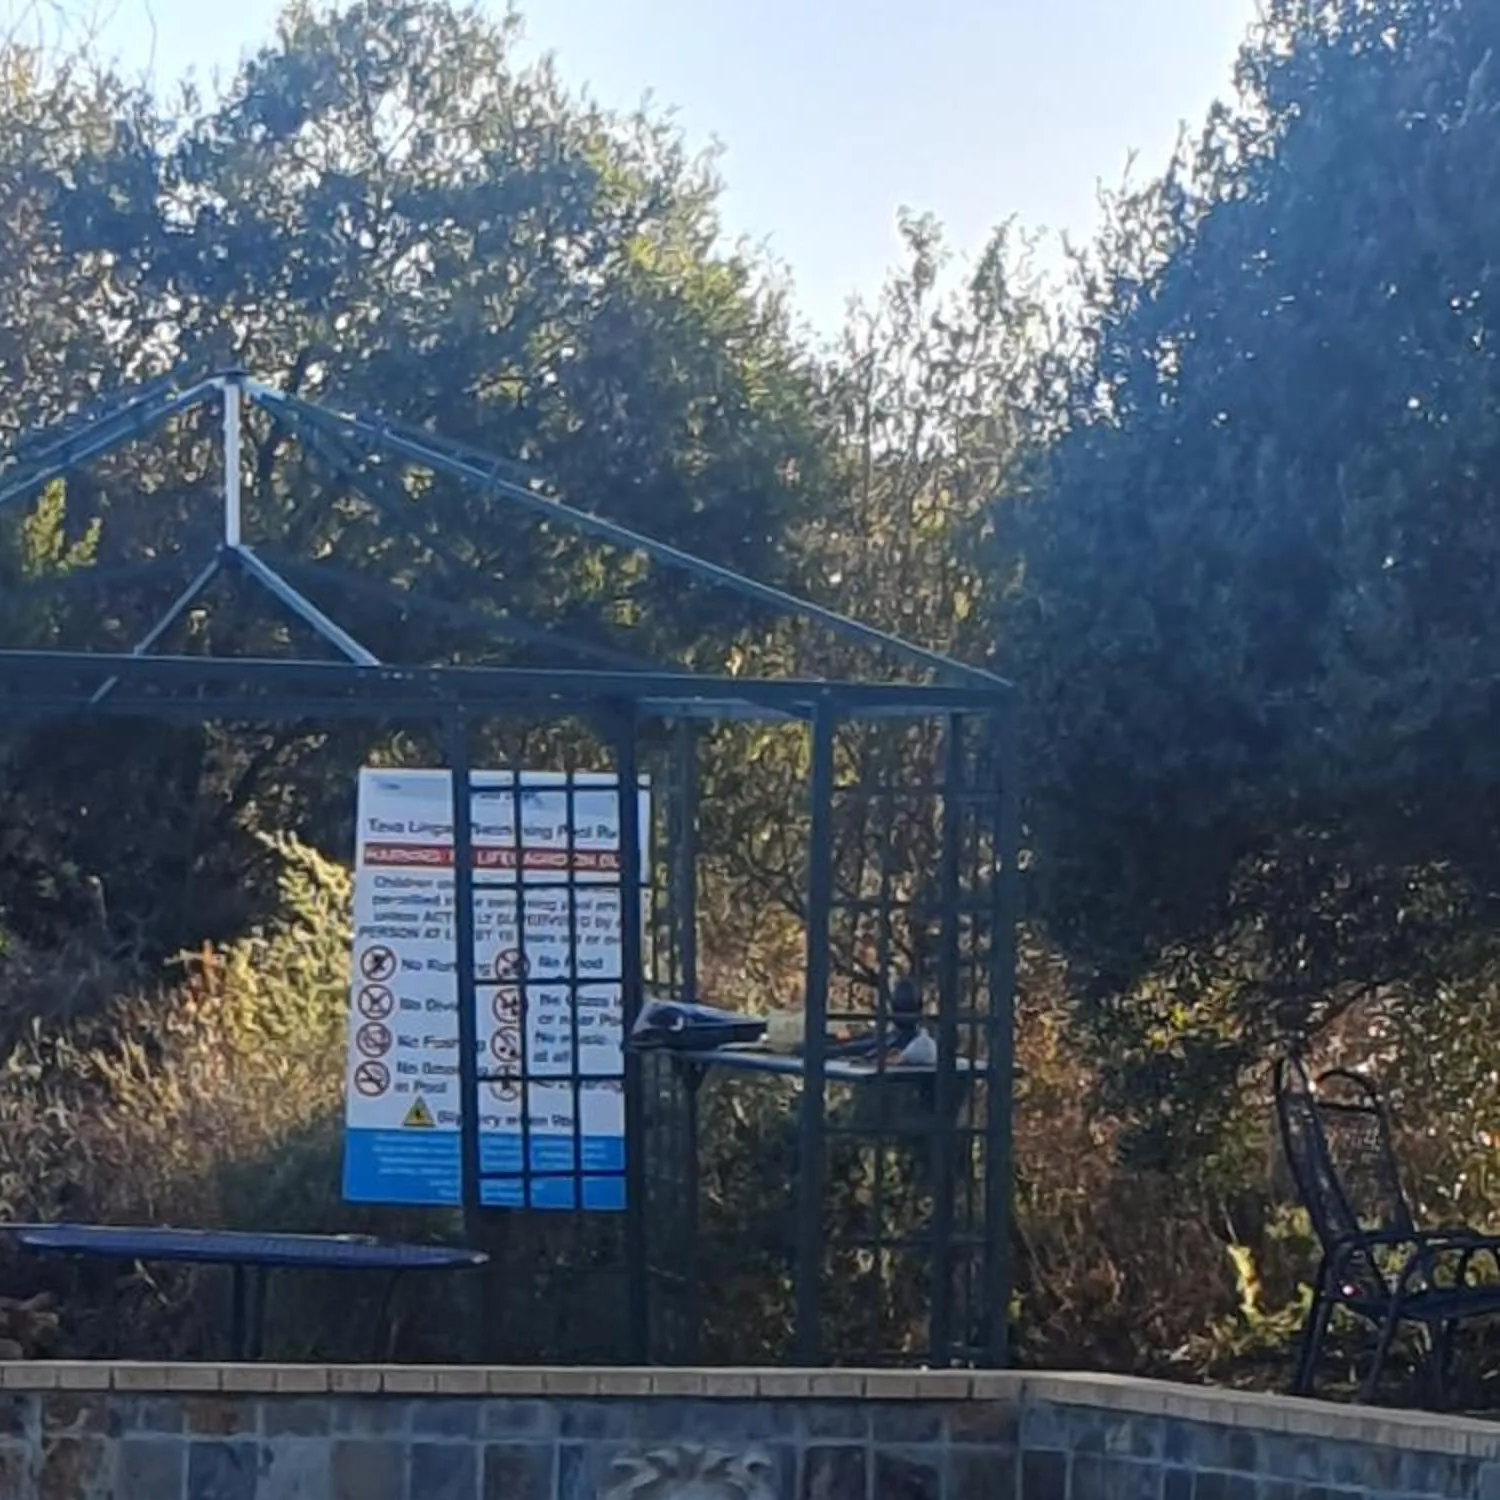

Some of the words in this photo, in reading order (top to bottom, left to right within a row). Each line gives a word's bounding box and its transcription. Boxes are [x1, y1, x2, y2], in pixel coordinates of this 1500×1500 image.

[557, 825, 592, 838] Pol
[374, 875, 433, 888] Children
[488, 898, 557, 911] swiming
[560, 901, 592, 912] pol
[497, 914, 590, 928] SUERVISD
[359, 925, 419, 939] PERSON
[402, 958, 422, 971] No
[427, 959, 491, 976] Runng
[538, 955, 559, 968] No
[399, 997, 421, 1010] No
[560, 1016, 594, 1026] nar
[397, 1035, 419, 1048] No
[396, 1061, 418, 1074] No
[414, 1080, 447, 1093] Pool
[437, 1110, 502, 1128] Slipry
